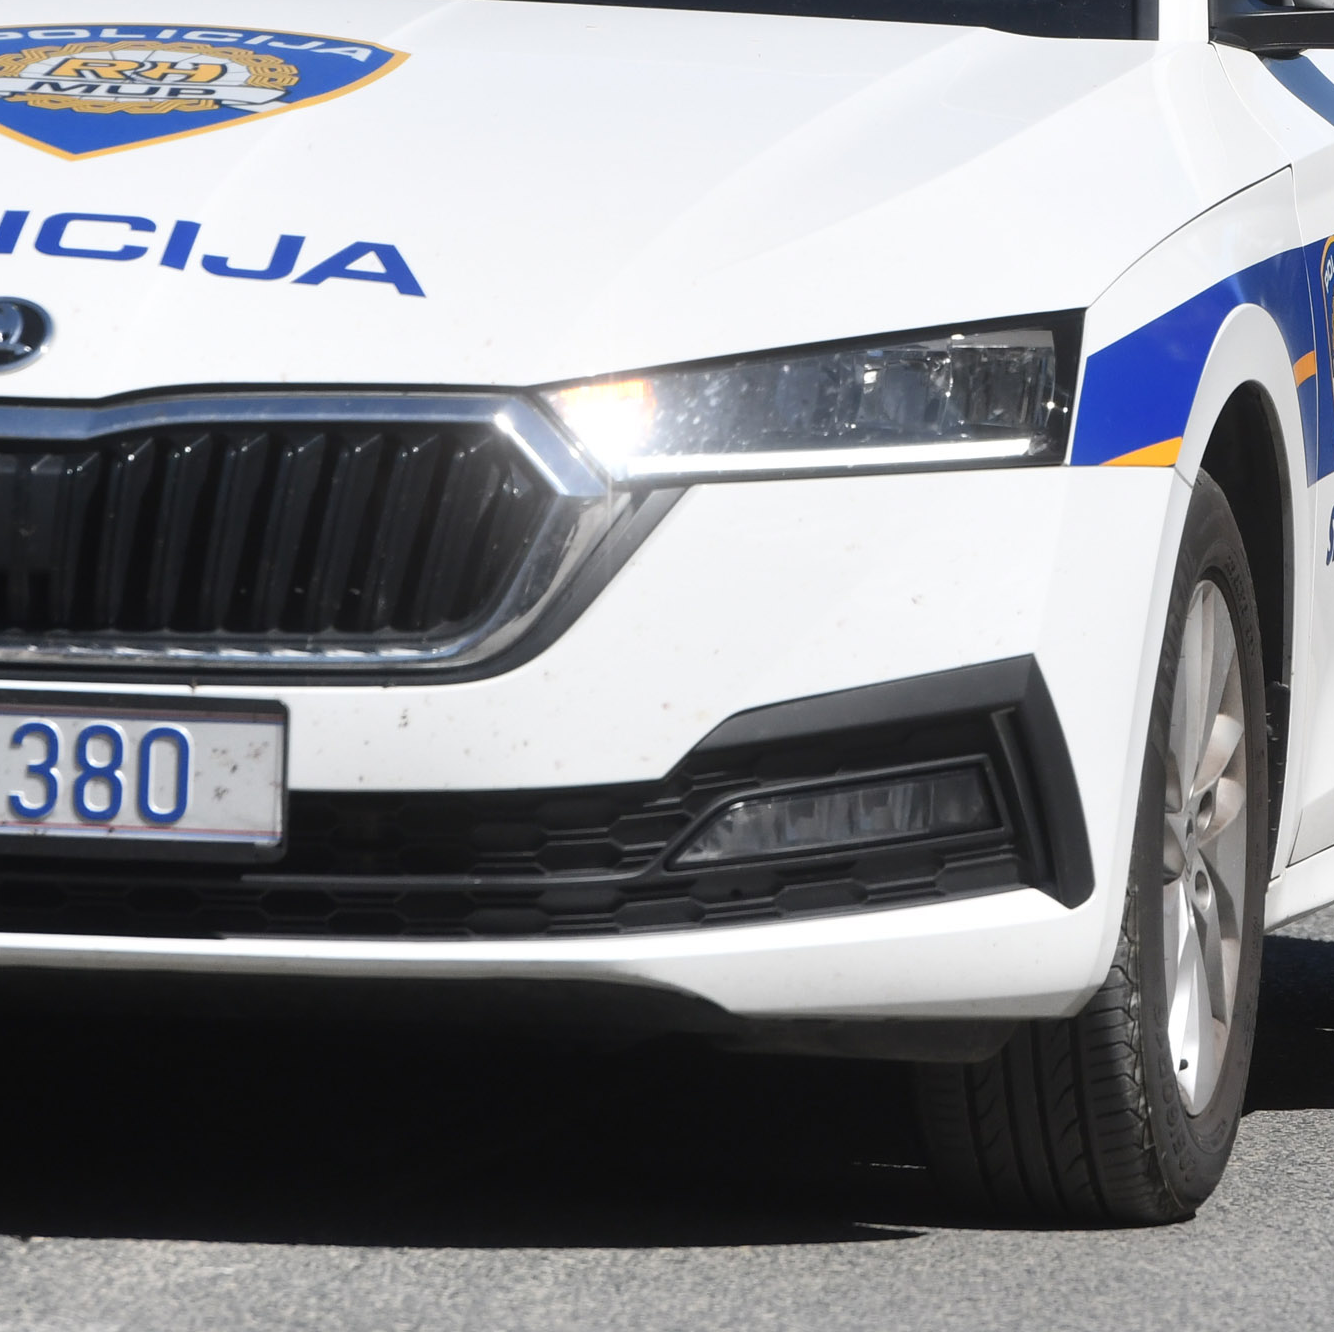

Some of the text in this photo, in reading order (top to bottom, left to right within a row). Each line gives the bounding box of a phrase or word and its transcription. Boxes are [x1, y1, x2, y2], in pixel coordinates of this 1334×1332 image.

[46, 58, 228, 84] RH
[27, 80, 217, 98] MUP
[8, 721, 191, 824] 380
